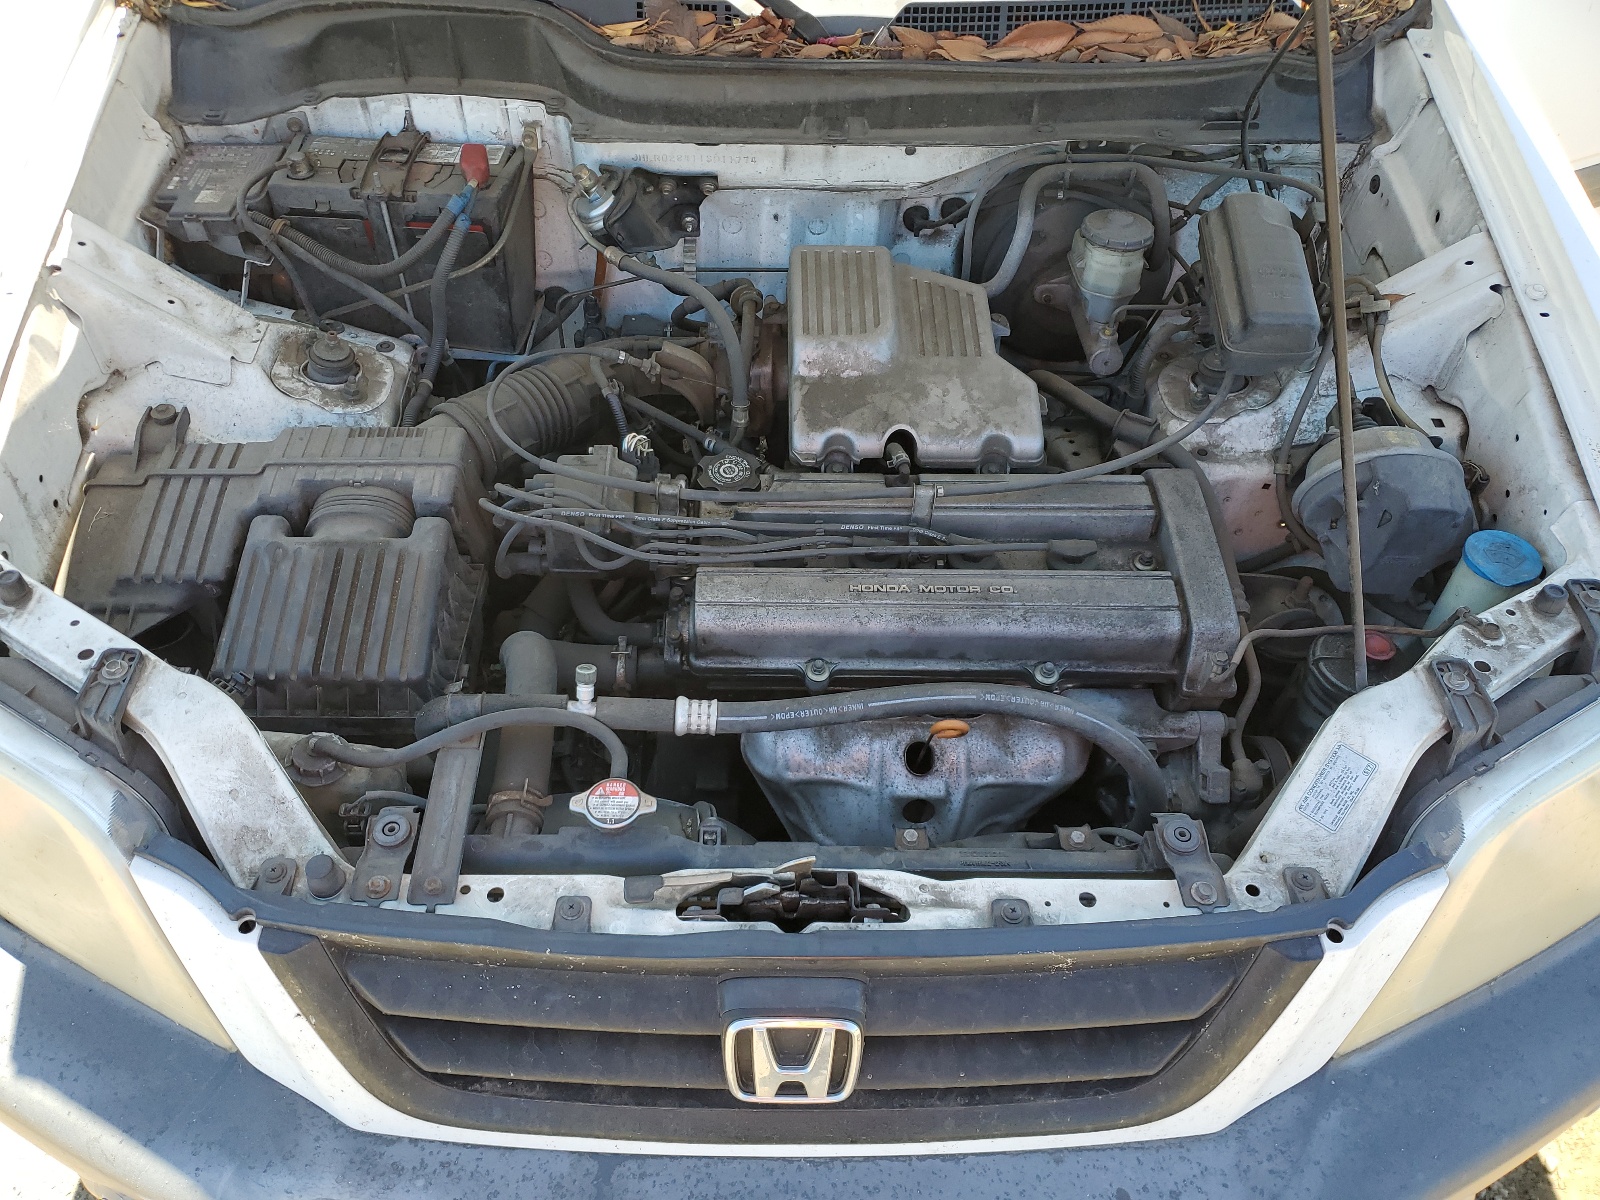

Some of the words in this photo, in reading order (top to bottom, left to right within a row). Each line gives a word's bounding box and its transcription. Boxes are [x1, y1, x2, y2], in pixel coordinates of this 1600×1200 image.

[849, 584, 911, 593] HONDA
[918, 584, 981, 594] MOTOR
[989, 584, 1018, 594] CO.
